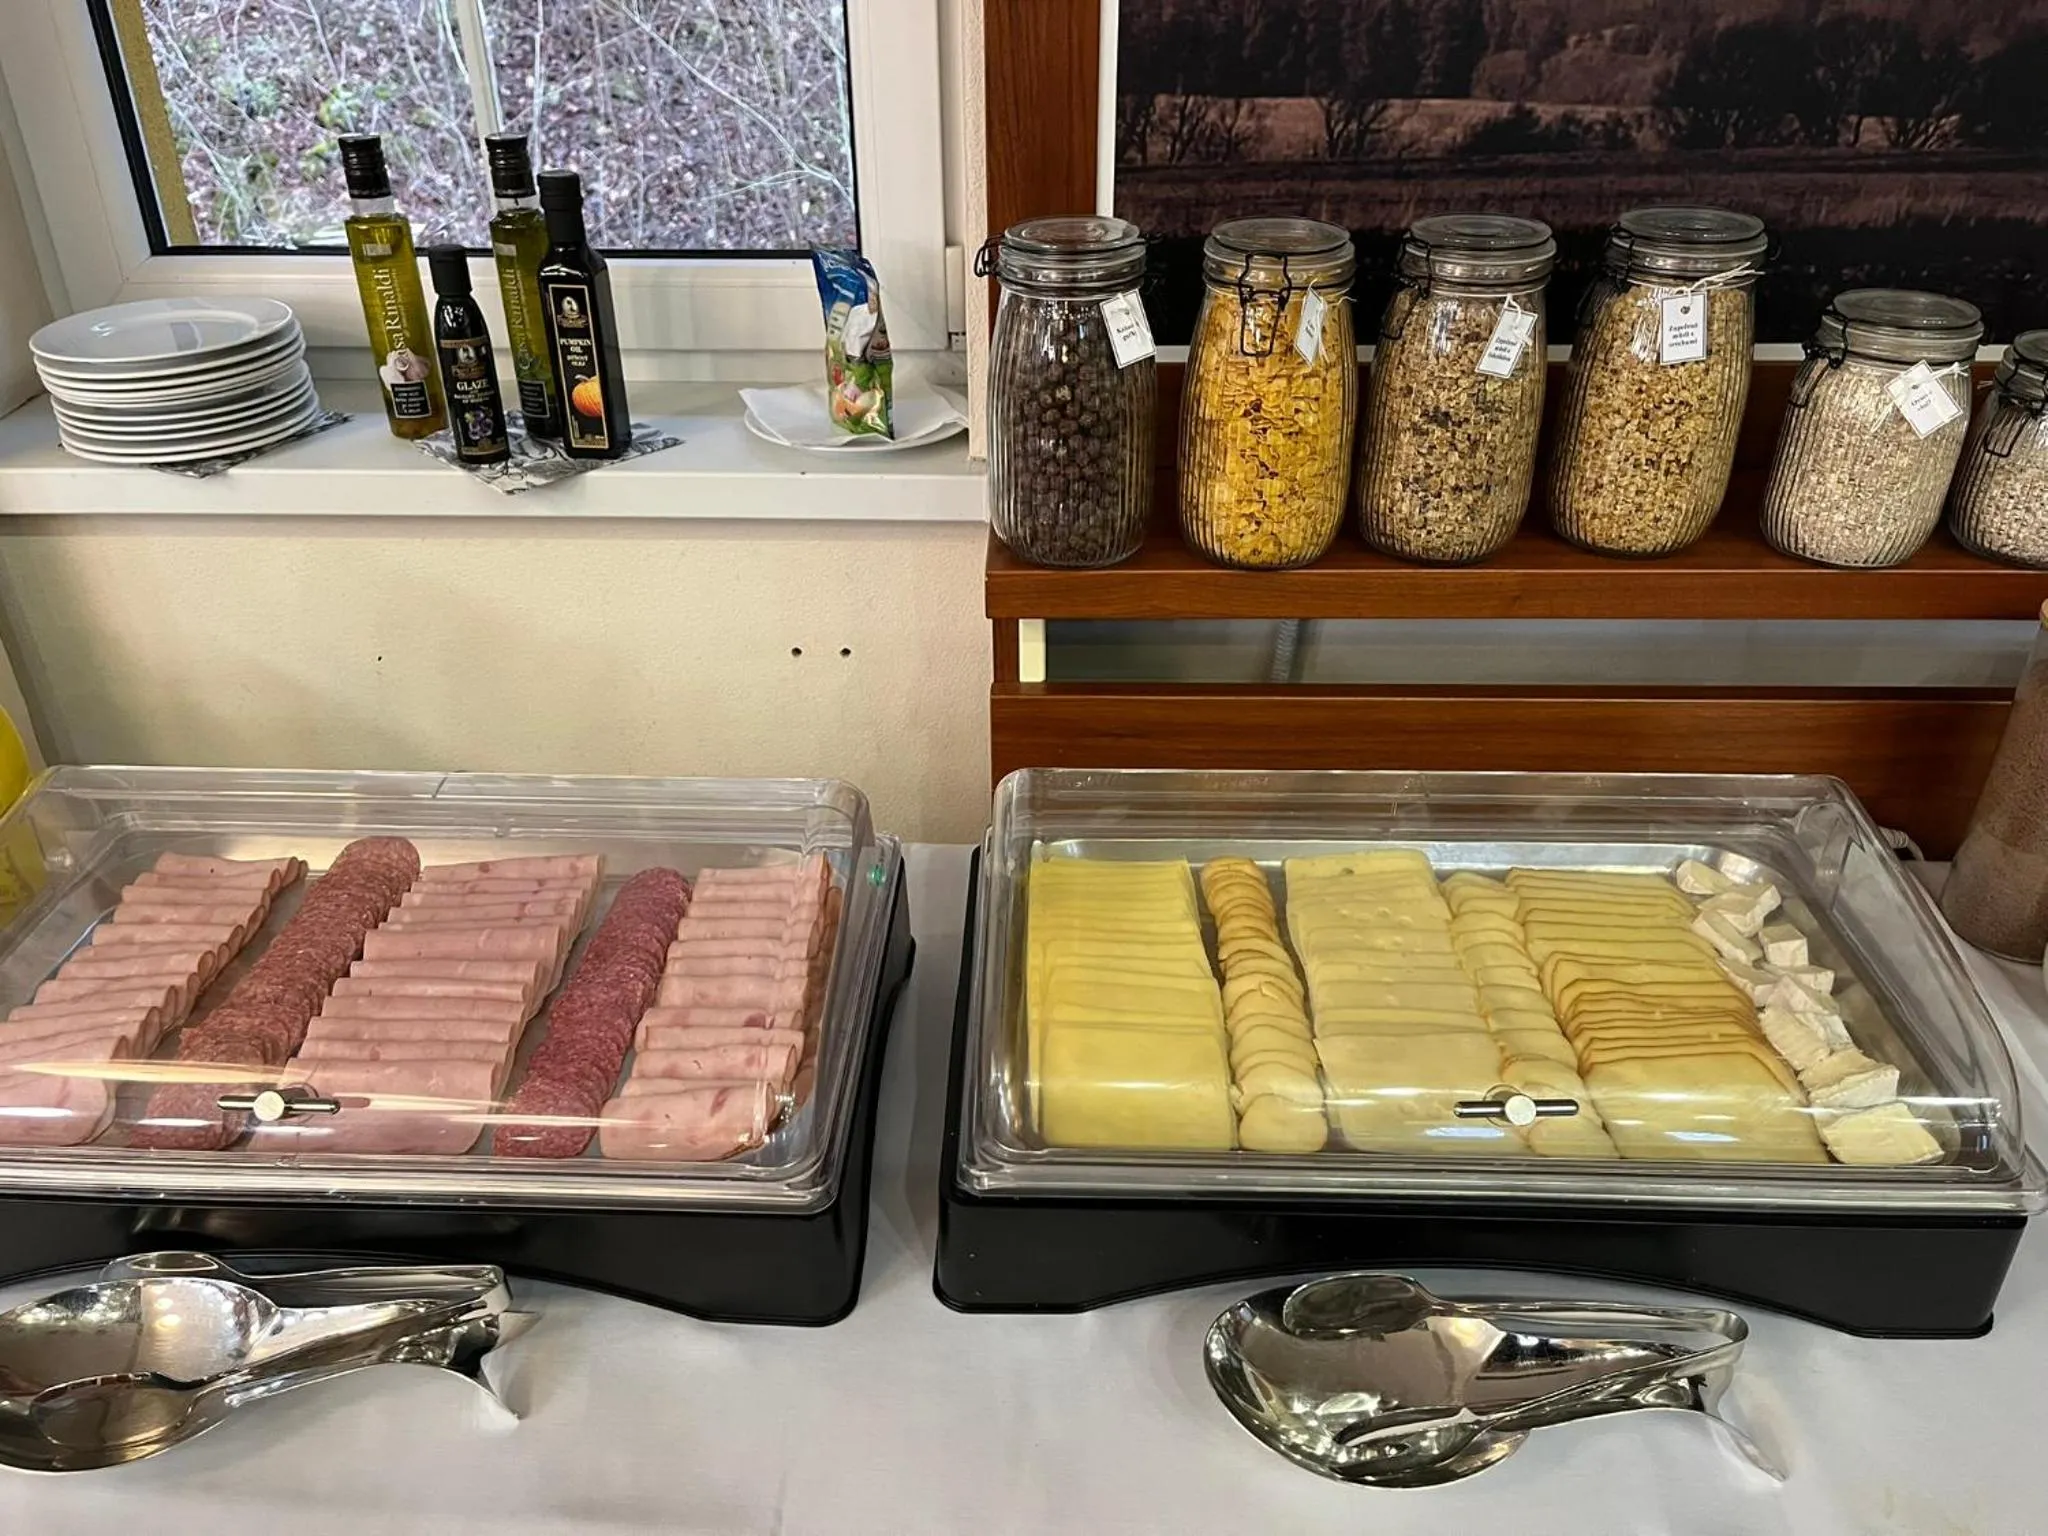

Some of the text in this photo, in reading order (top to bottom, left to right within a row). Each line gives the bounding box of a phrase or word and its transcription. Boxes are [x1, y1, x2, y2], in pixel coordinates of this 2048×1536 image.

[373, 268, 401, 330] Rinaldi
[502, 268, 524, 329] Rinaldi
[392, 333, 410, 371] Casa
[559, 338, 592, 346] PUMPKIN
[456, 379, 489, 391] GLAZE
